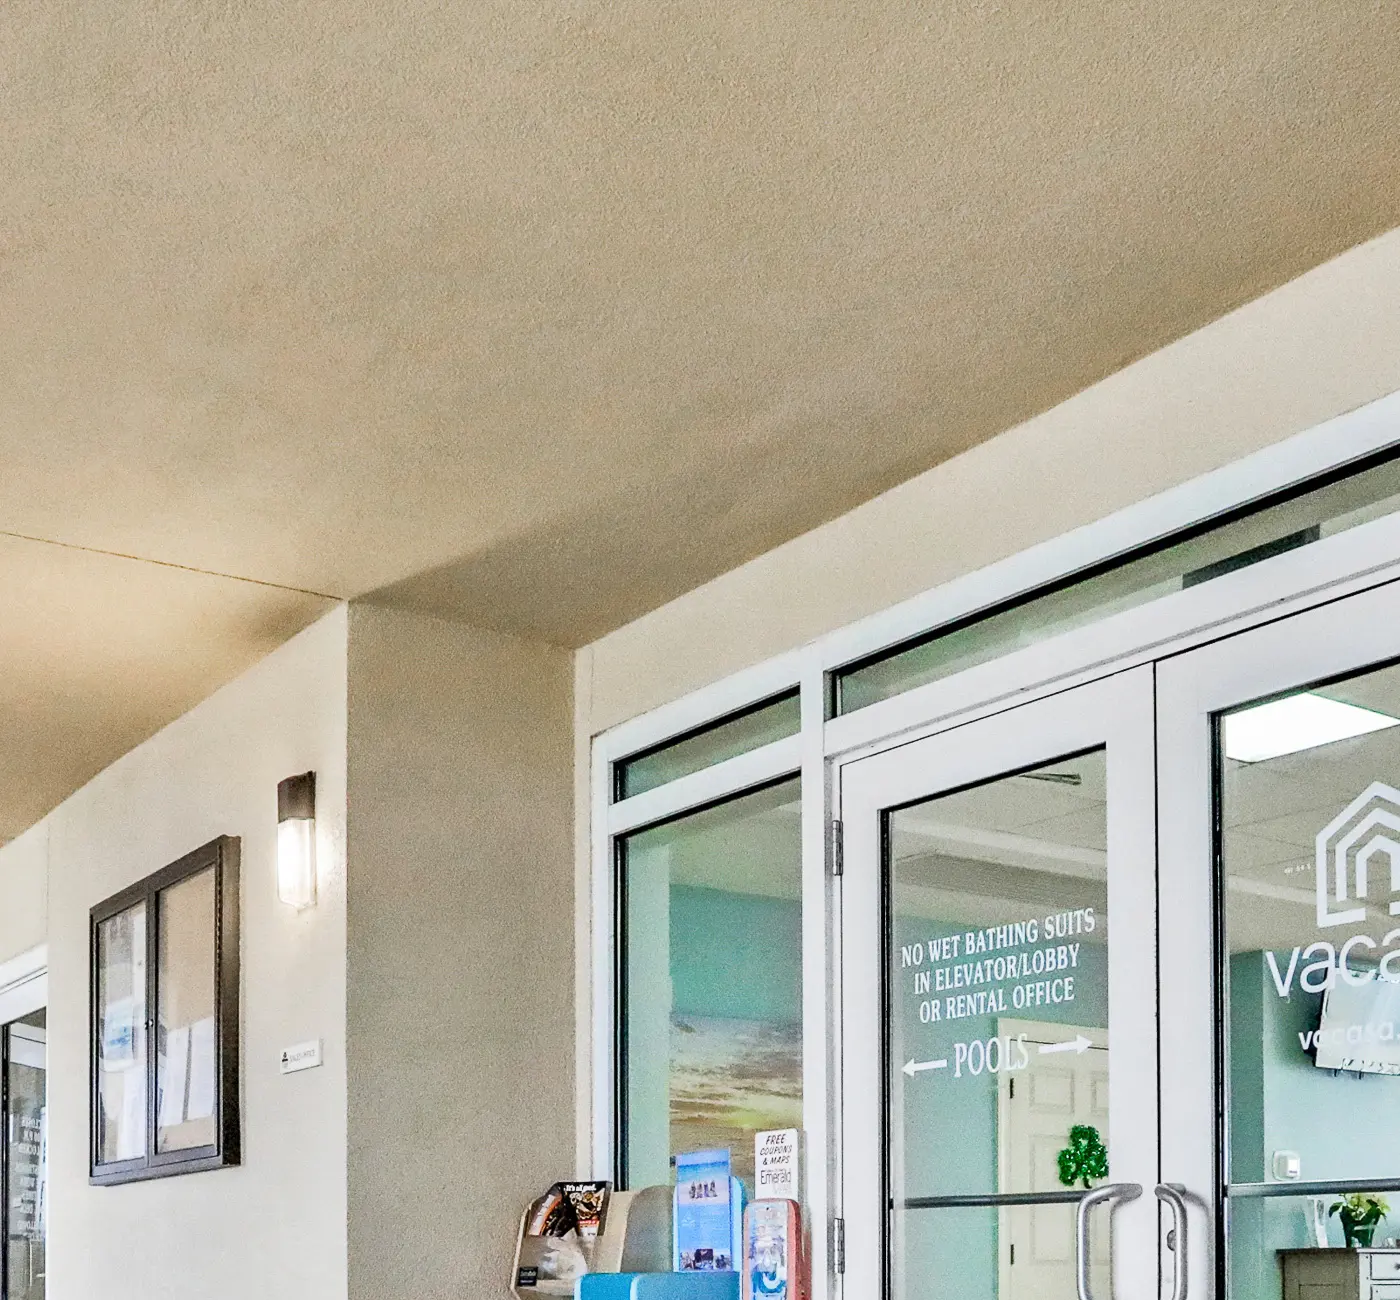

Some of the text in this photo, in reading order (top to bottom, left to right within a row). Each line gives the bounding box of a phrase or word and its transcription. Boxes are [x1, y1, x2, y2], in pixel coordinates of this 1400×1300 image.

[902, 907, 1095, 968] NO WET BATHING SUITS
[914, 943, 1080, 995] IN ELEVATOR/LOBBY
[919, 976, 1075, 1024] OR RENTAL OFFICE
[953, 1033, 1029, 1078] POOLS
[760, 1145, 792, 1156] COUPONS
[766, 1134, 786, 1144] FREE
[770, 1156, 790, 1164] MAPS
[761, 1169, 791, 1184] Emerald
